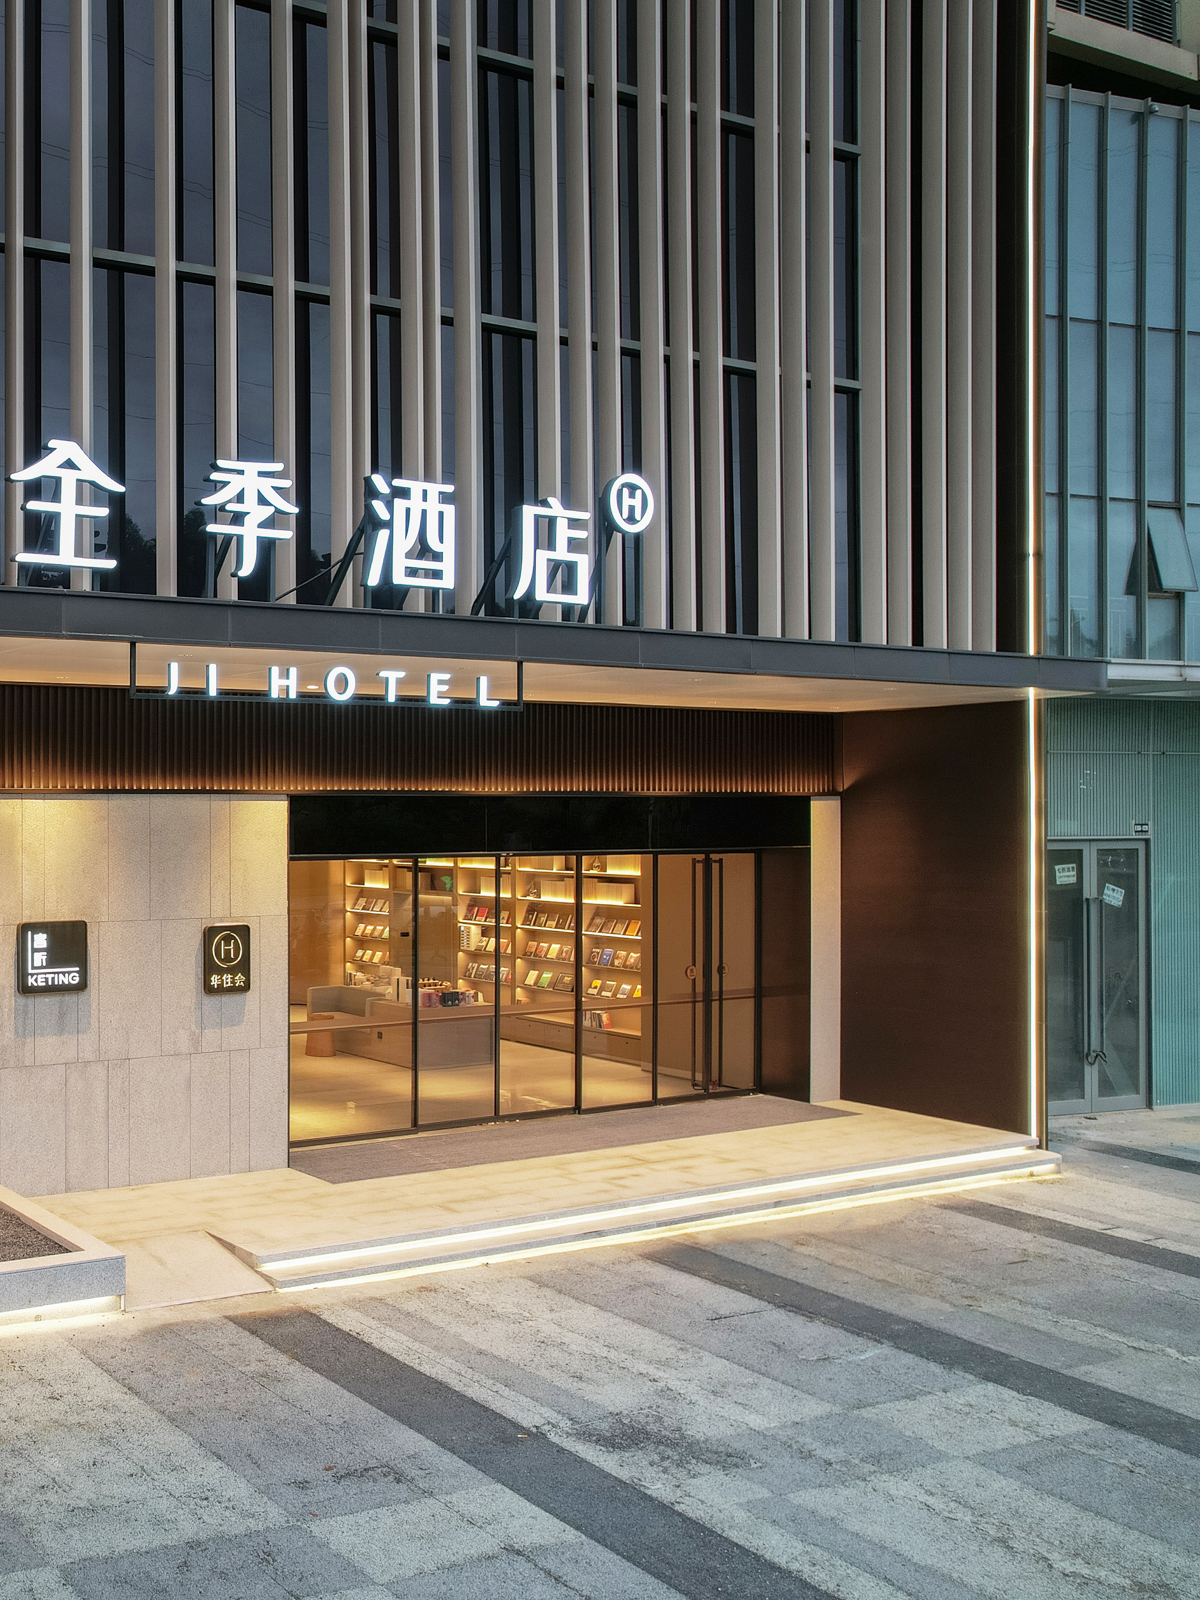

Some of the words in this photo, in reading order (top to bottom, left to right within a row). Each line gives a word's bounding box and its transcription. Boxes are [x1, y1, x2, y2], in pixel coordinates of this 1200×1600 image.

[9, 439, 591, 605] 全季酒店
[167, 661, 217, 697] JI
[270, 665, 500, 707] HOTEL
[28, 972, 80, 987] KETING
[210, 972, 246, 989] 华住会
